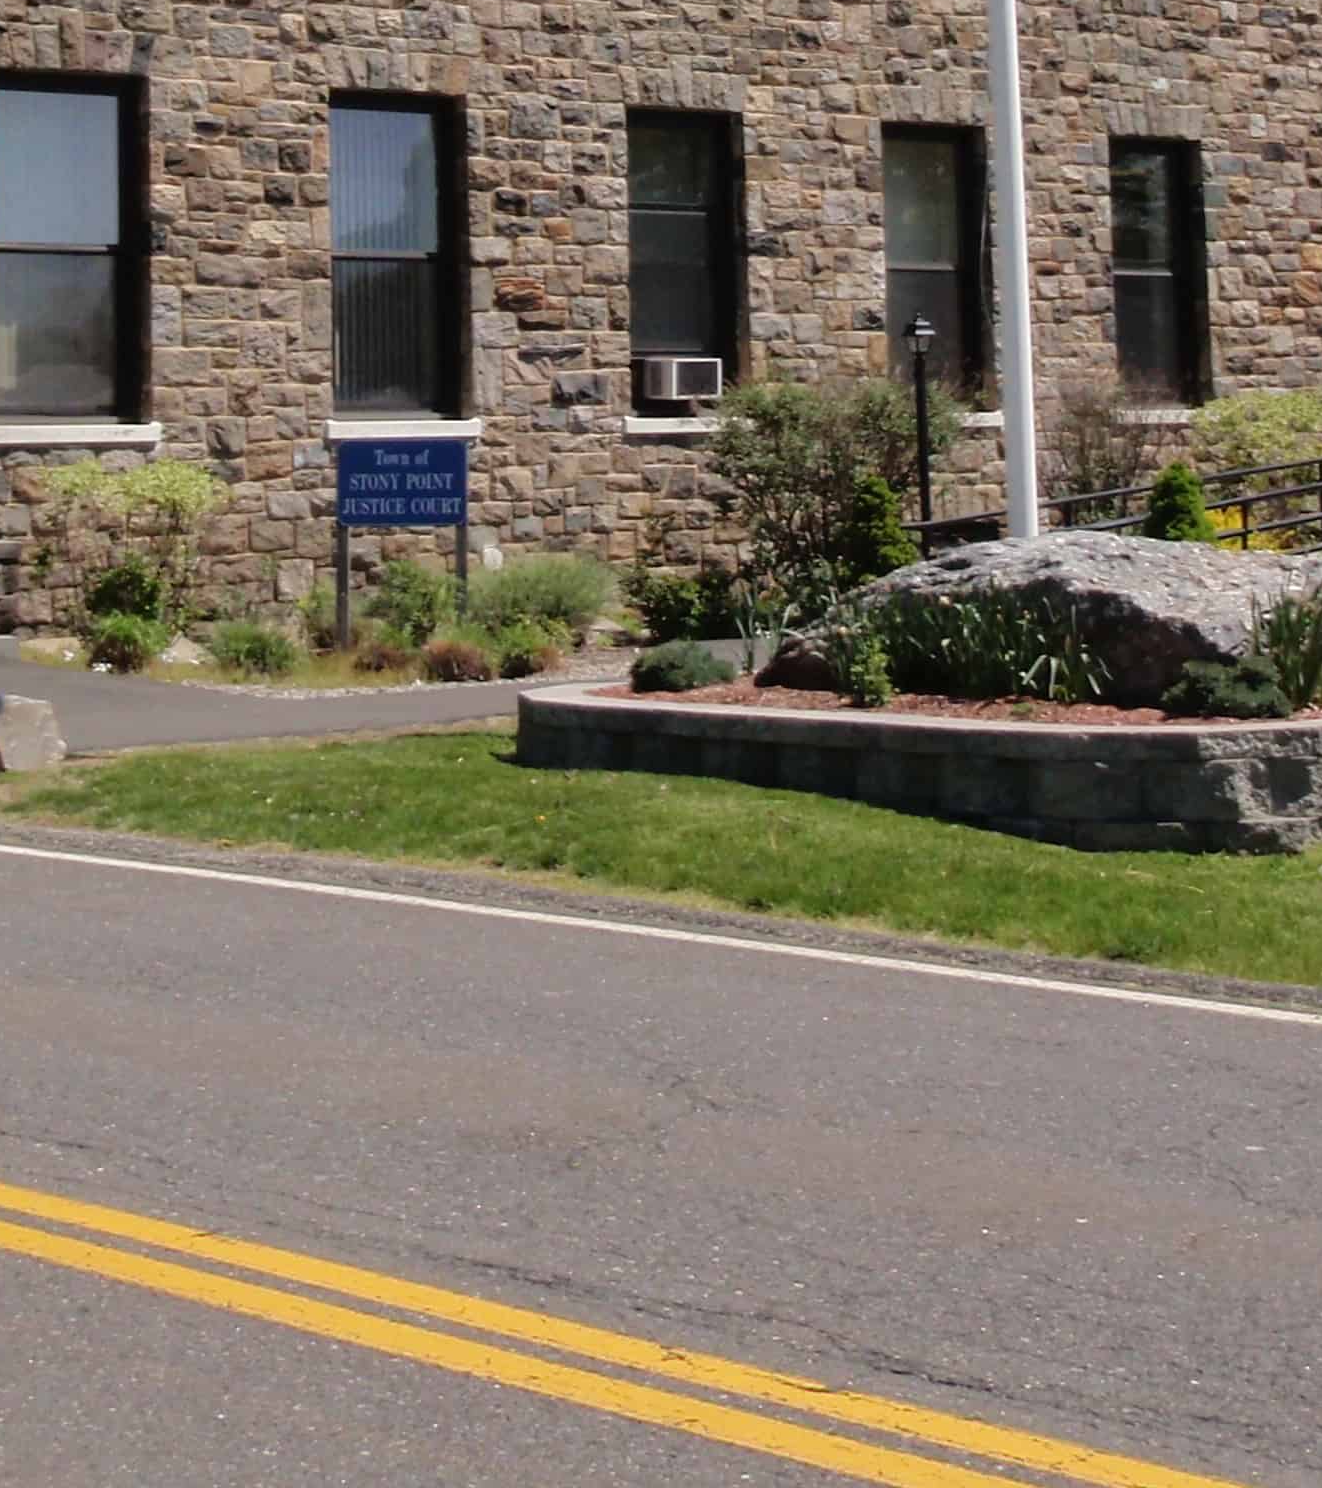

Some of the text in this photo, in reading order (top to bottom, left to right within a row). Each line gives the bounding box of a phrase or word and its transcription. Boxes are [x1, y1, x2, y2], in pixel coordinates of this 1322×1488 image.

[374, 449, 430, 465] Town of
[349, 472, 454, 491] STONY POINT
[342, 497, 462, 516] JUSTICE COURT
